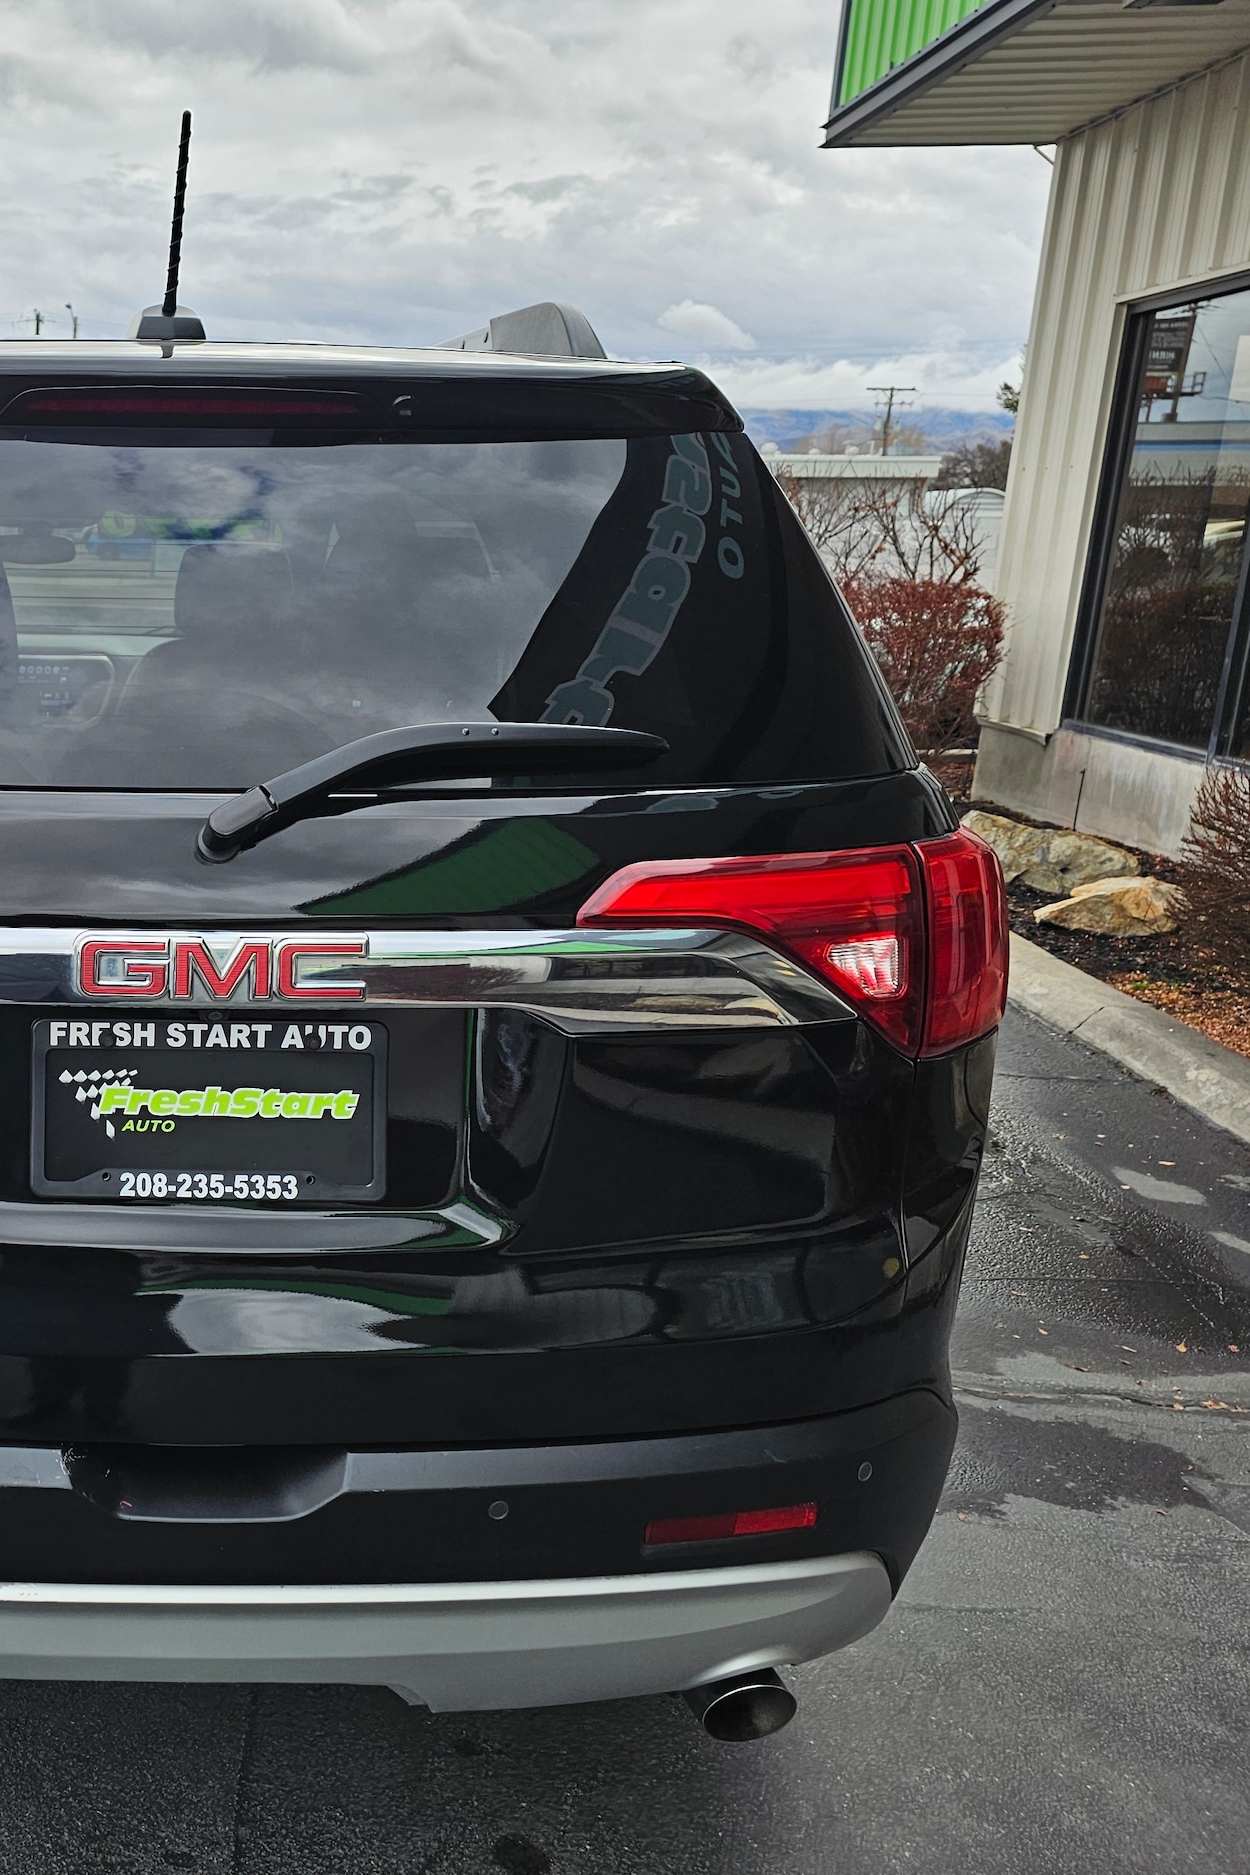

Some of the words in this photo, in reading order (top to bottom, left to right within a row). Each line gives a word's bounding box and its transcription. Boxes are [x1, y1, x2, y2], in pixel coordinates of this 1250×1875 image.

[76, 931, 369, 1001] GMC
[49, 1021, 155, 1047] FRESH
[166, 1023, 272, 1049] START
[281, 1024, 372, 1050] AUTO
[98, 1084, 360, 1120] FreshStart
[121, 1119, 176, 1133] AUTO
[119, 1171, 299, 1200] 208-235-5353
